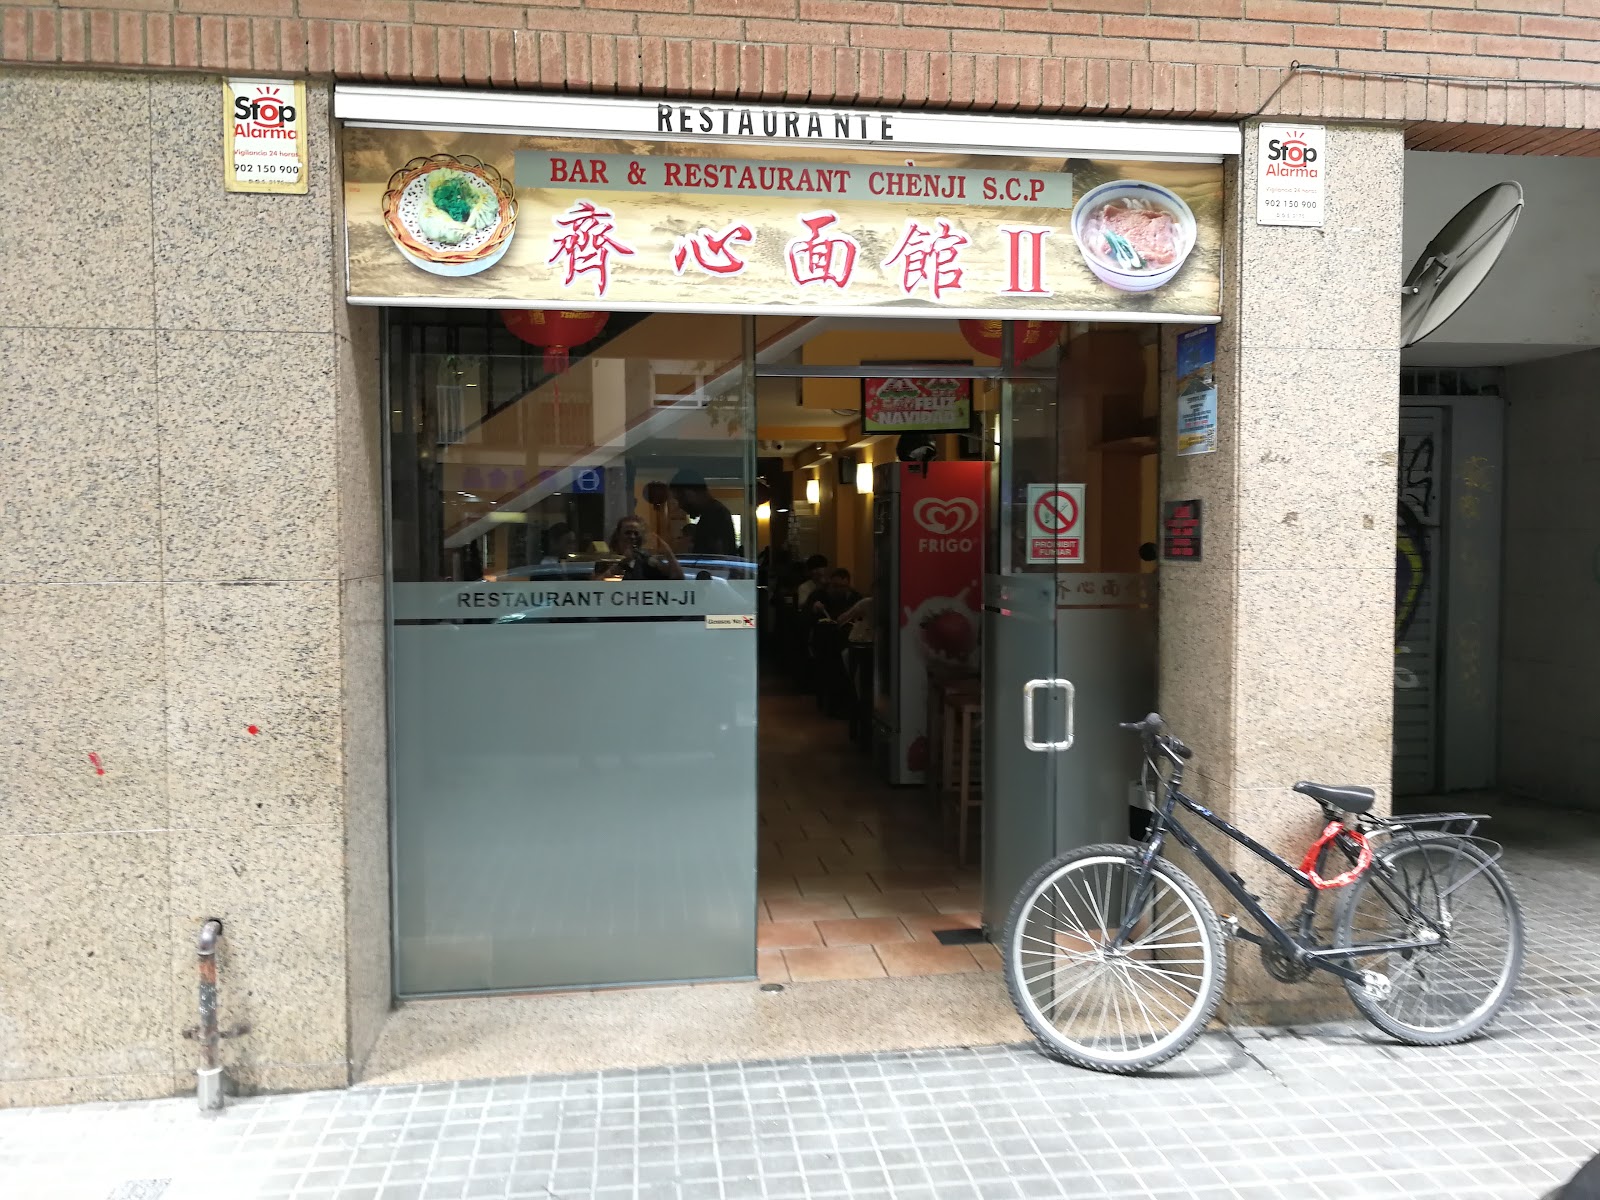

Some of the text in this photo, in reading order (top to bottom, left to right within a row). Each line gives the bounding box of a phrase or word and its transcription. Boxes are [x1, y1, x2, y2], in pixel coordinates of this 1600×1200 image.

[235, 96, 296, 128] Stop
[657, 103, 894, 140] RESTAURANTE
[233, 123, 299, 139] Alarma
[1268, 139, 1318, 168] Stop
[234, 164, 299, 175] 902 150 900
[1266, 163, 1318, 178] Alarma
[550, 158, 1046, 202] BAR & RESTAURANT CHENJI S.C.P
[1284, 200, 1299, 208] 150
[1301, 201, 1317, 209] 900
[918, 539, 973, 553] FRIGO
[457, 591, 695, 608] RESTAURANT CHEN-JI
